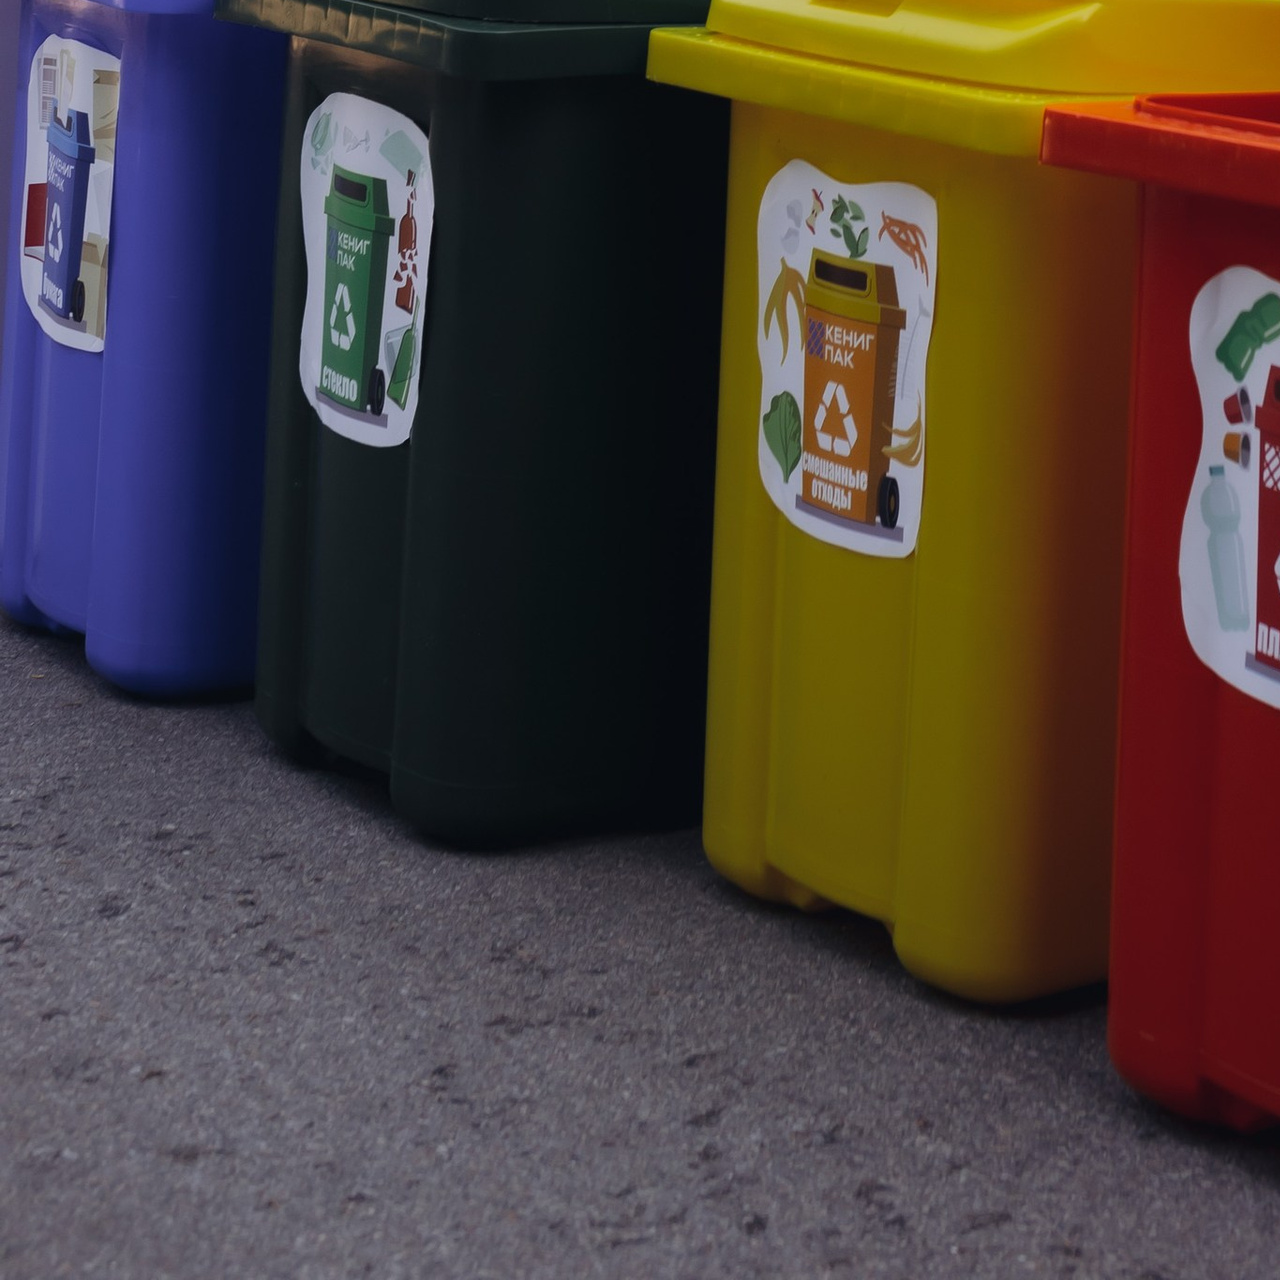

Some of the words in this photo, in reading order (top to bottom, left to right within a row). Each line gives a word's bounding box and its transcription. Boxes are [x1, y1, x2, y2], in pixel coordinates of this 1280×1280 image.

[336, 230, 371, 255] КЕНИГ
[336, 249, 355, 272] ПАК
[824, 323, 875, 352] КЕНИГ
[824, 345, 854, 370] ПАК
